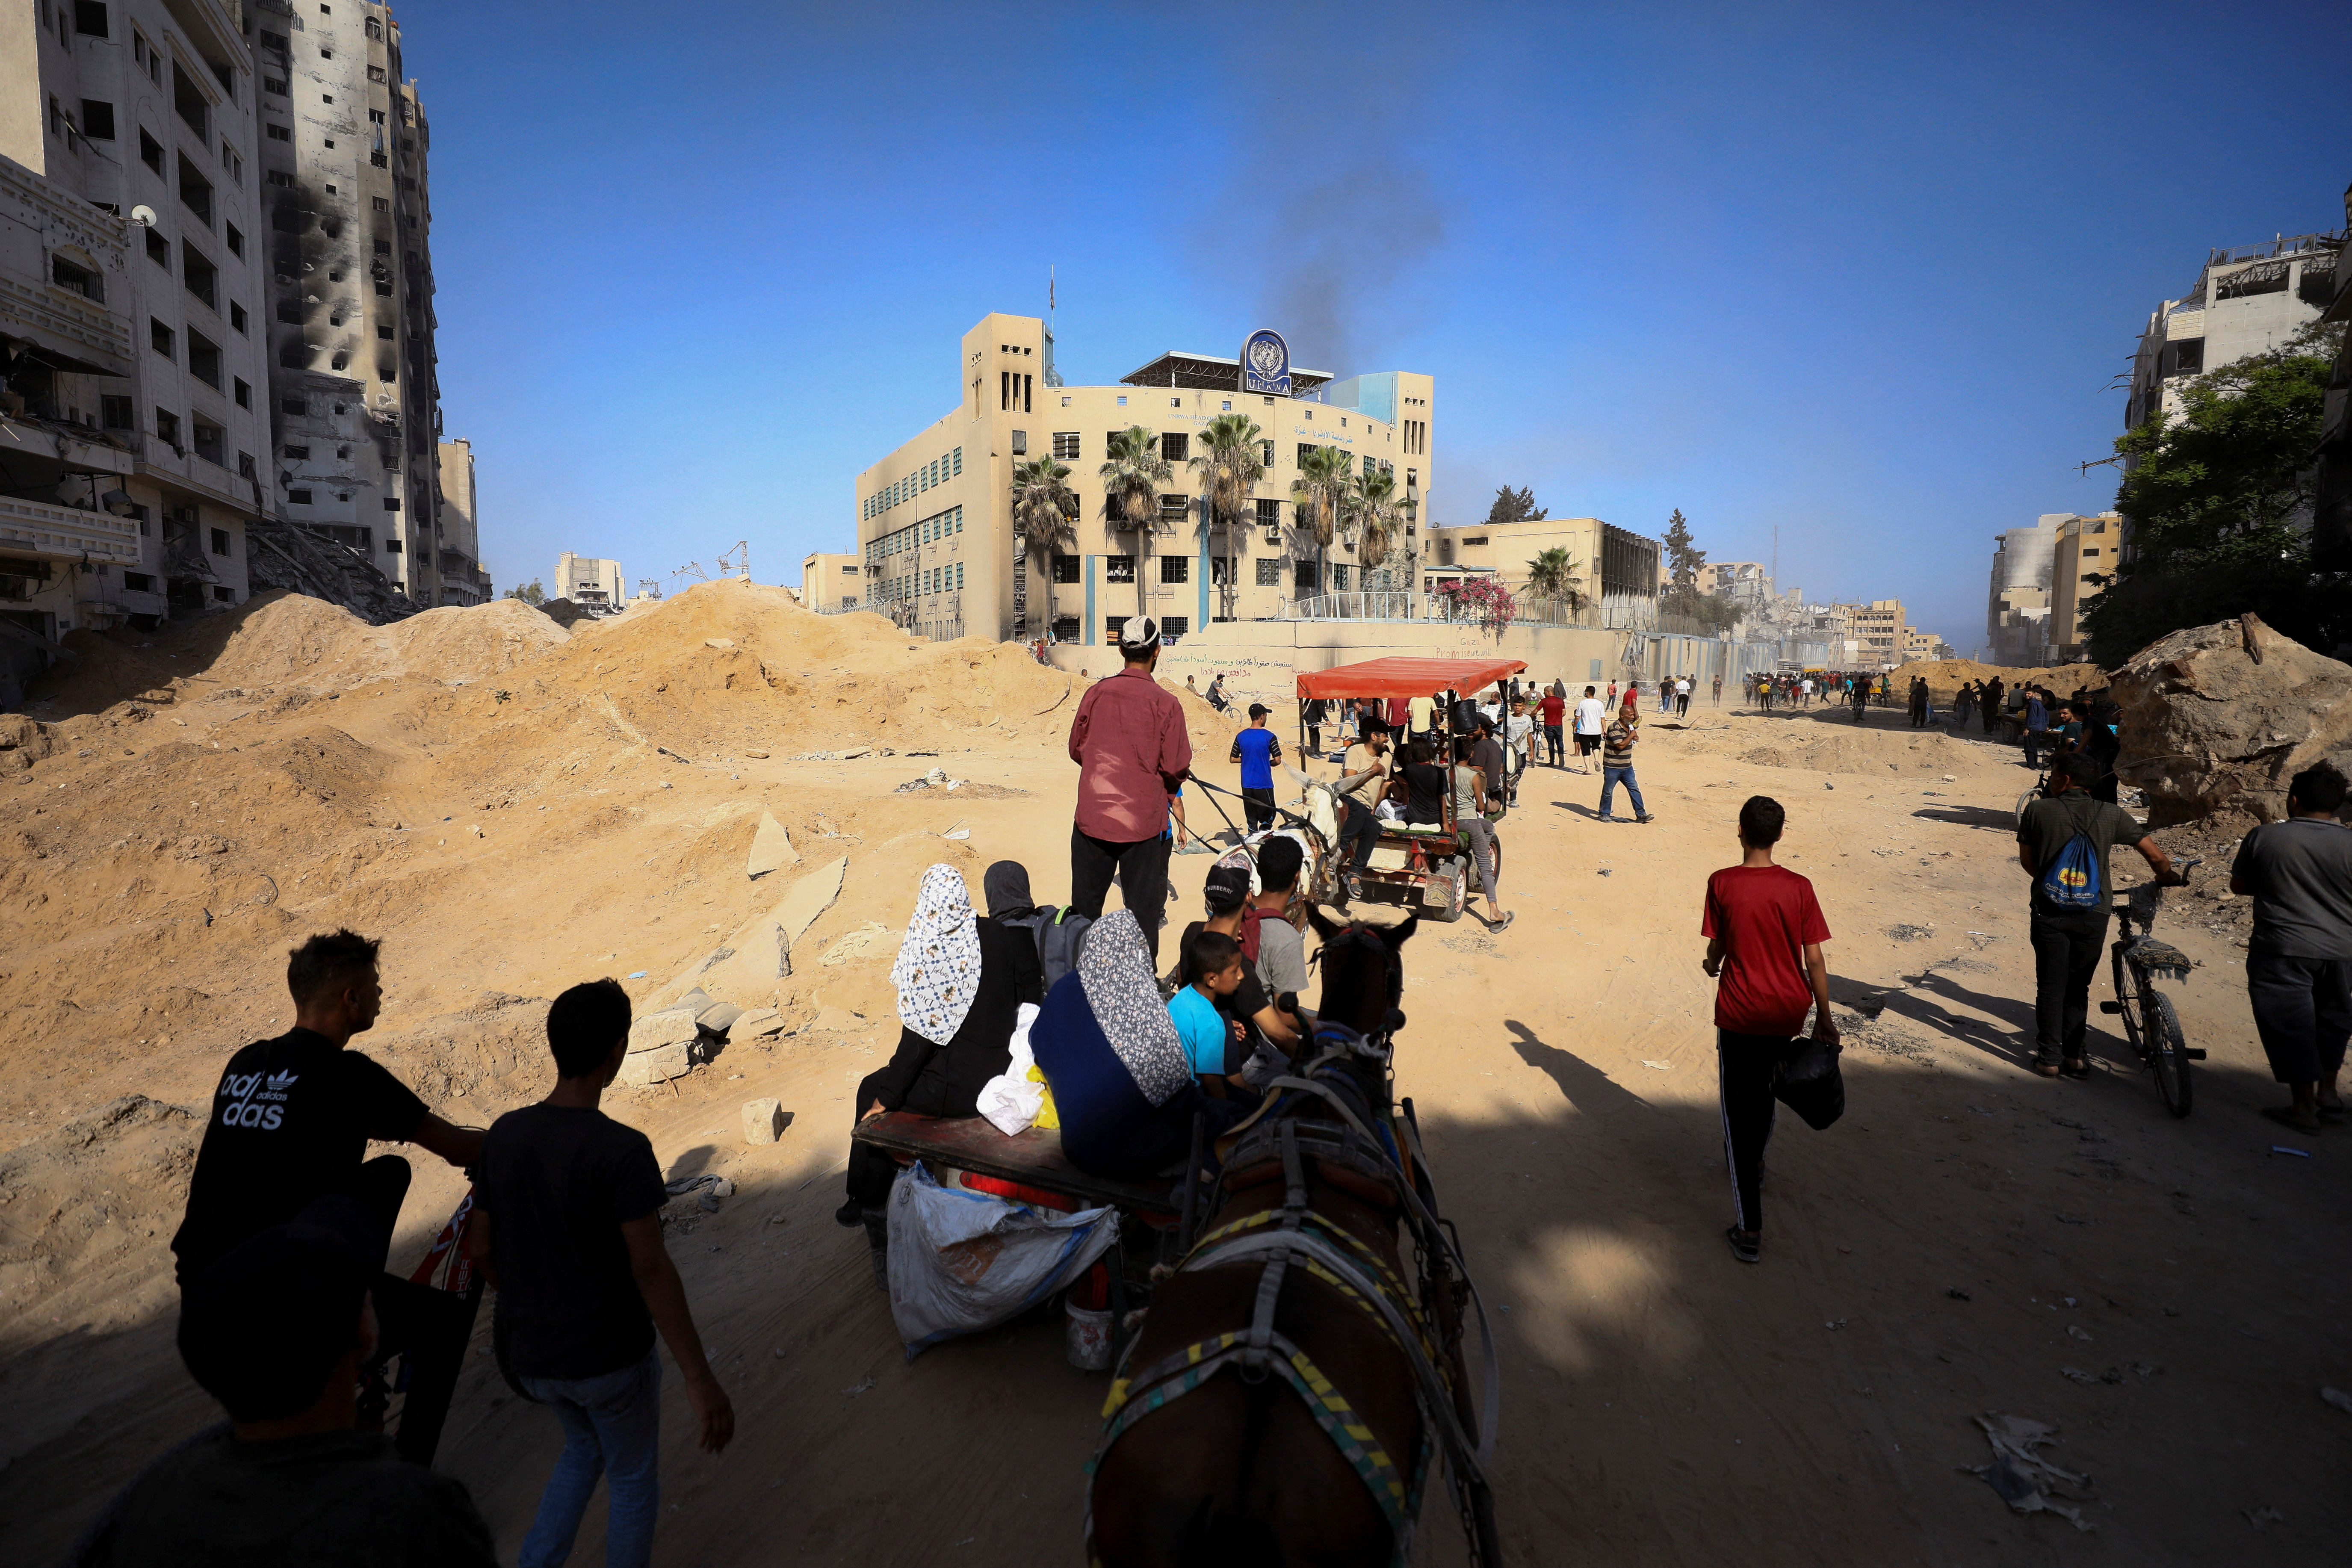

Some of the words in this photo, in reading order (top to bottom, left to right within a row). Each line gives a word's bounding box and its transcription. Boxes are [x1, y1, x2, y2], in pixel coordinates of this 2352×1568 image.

[1460, 638, 1480, 646] Gaza
[1436, 647, 1470, 659] Promise
[1165, 654, 1189, 664] شامخين
[1271, 660, 1292, 668] سنعيش
[1200, 667, 1214, 676] بلادنا
[1226, 668, 1251, 679] مدافعين
[1207, 885, 1234, 895] BURBERRY
[910, 942, 919, 961] Dior
[946, 942, 964, 954] Dior
[962, 980, 976, 991] Dio
[914, 992, 934, 1007] Dior
[257, 1091, 288, 1101] adidas
